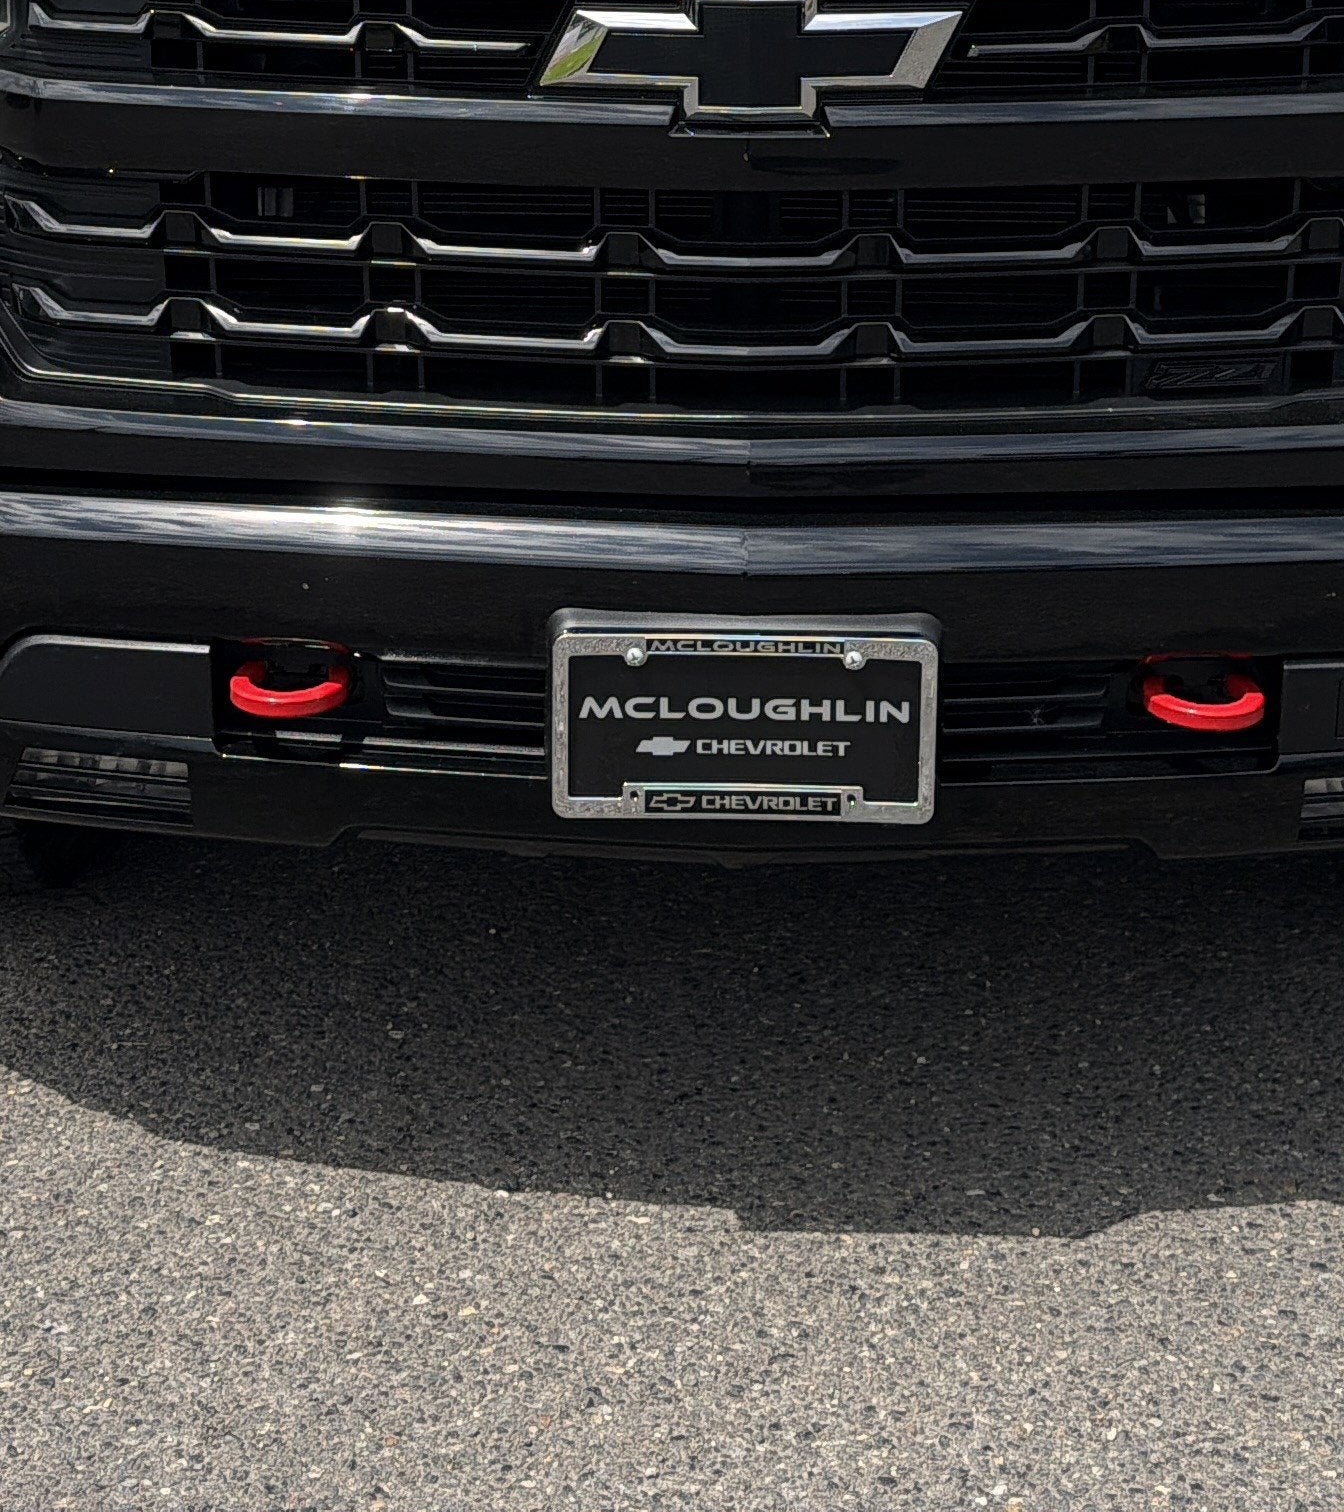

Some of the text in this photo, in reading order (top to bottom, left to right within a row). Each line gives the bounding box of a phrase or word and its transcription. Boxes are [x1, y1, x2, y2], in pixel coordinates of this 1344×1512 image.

[650, 639, 842, 654] MCLOUGHLIN
[578, 696, 910, 724] MCLOUGHLIN
[696, 739, 851, 757] CHEVROLET
[701, 794, 838, 812] CHEVROLET
